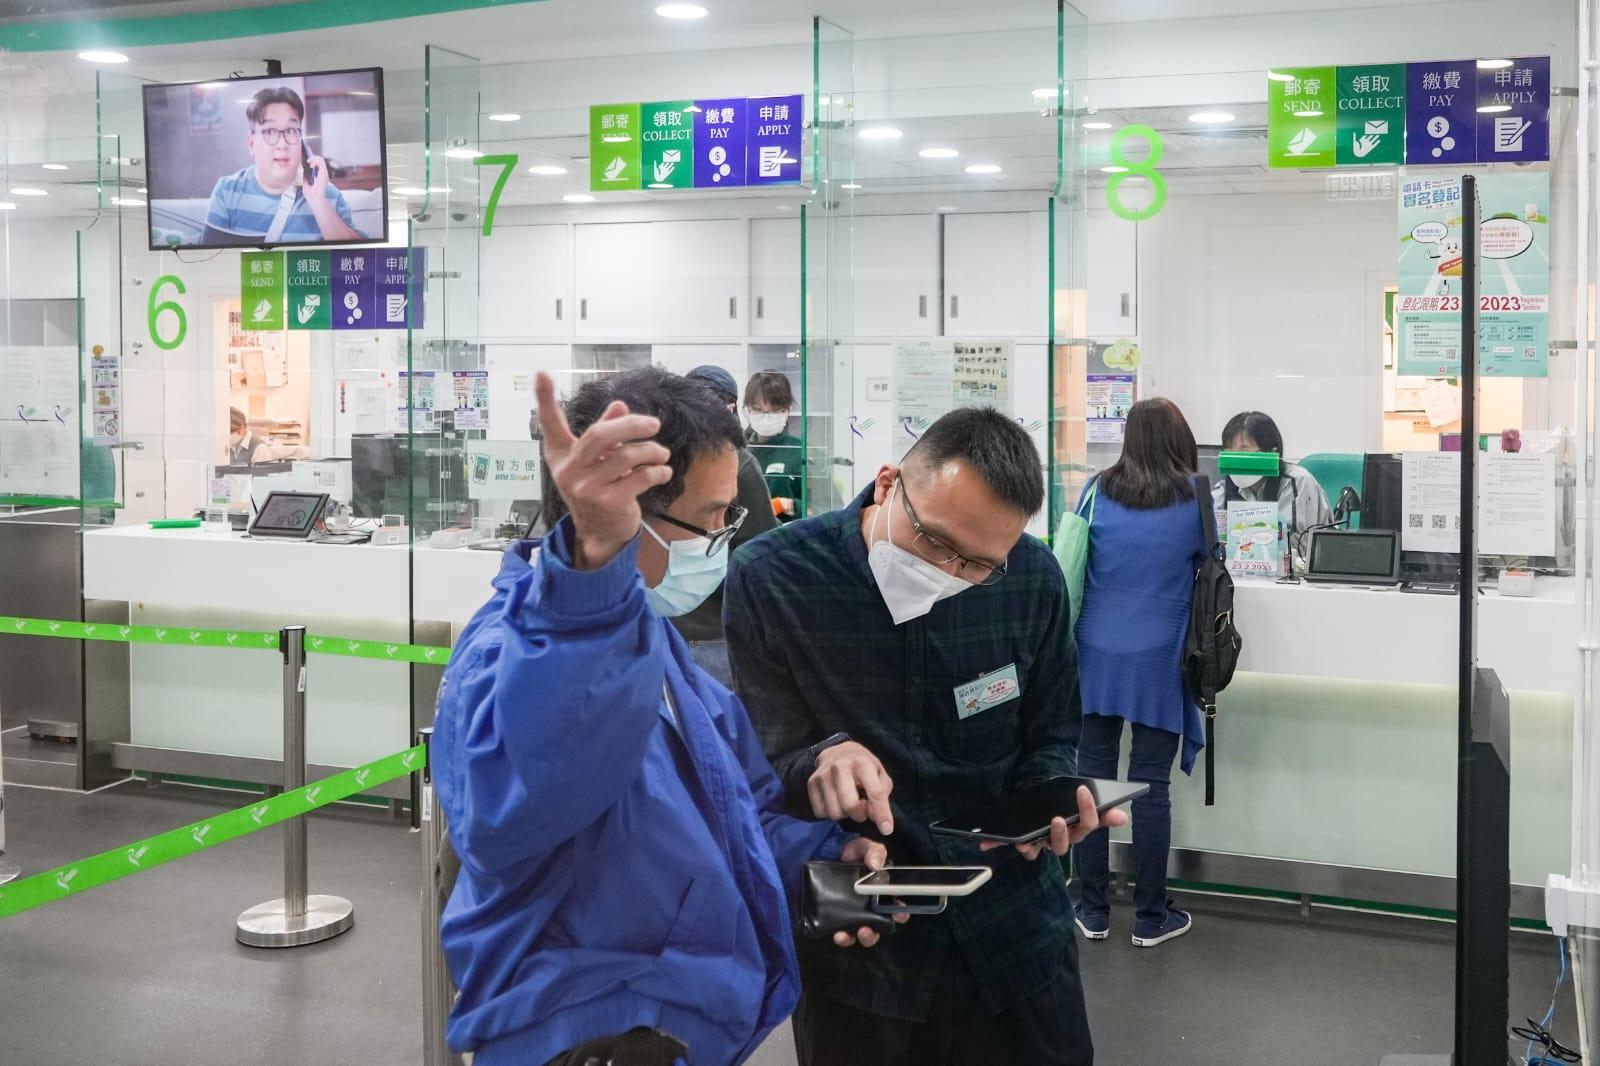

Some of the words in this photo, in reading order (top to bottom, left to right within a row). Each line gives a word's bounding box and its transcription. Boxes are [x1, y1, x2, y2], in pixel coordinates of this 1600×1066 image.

[1284, 78, 1321, 97] 郵寄
[1352, 75, 1390, 93] 領取
[1422, 71, 1461, 90] 繳費
[1494, 69, 1533, 88] 申請
[1283, 100, 1321, 113] SEND
[1338, 96, 1404, 110] COLLECT
[1428, 94, 1455, 107] PAY
[1491, 91, 1536, 105] APPLY
[601, 114, 629, 129] 郵寄
[653, 111, 682, 127] 領取
[705, 107, 735, 125] 繳費
[759, 105, 789, 121] 申請
[642, 129, 692, 142] COLLECT
[709, 127, 730, 139] PAY
[757, 124, 792, 137] APPLY
[1104, 124, 1168, 222] 8
[473, 154, 519, 236] 7
[1404, 186, 1460, 208] 實名登記
[250, 259, 274, 274] 郵寄
[297, 258, 321, 273] 領取
[340, 256, 365, 272] 繳費
[250, 275, 274, 287] SEND
[288, 275, 329, 287] COLLECT
[344, 274, 361, 285] PAY
[147, 274, 188, 350] 6
[495, 459, 536, 472] 智方便
